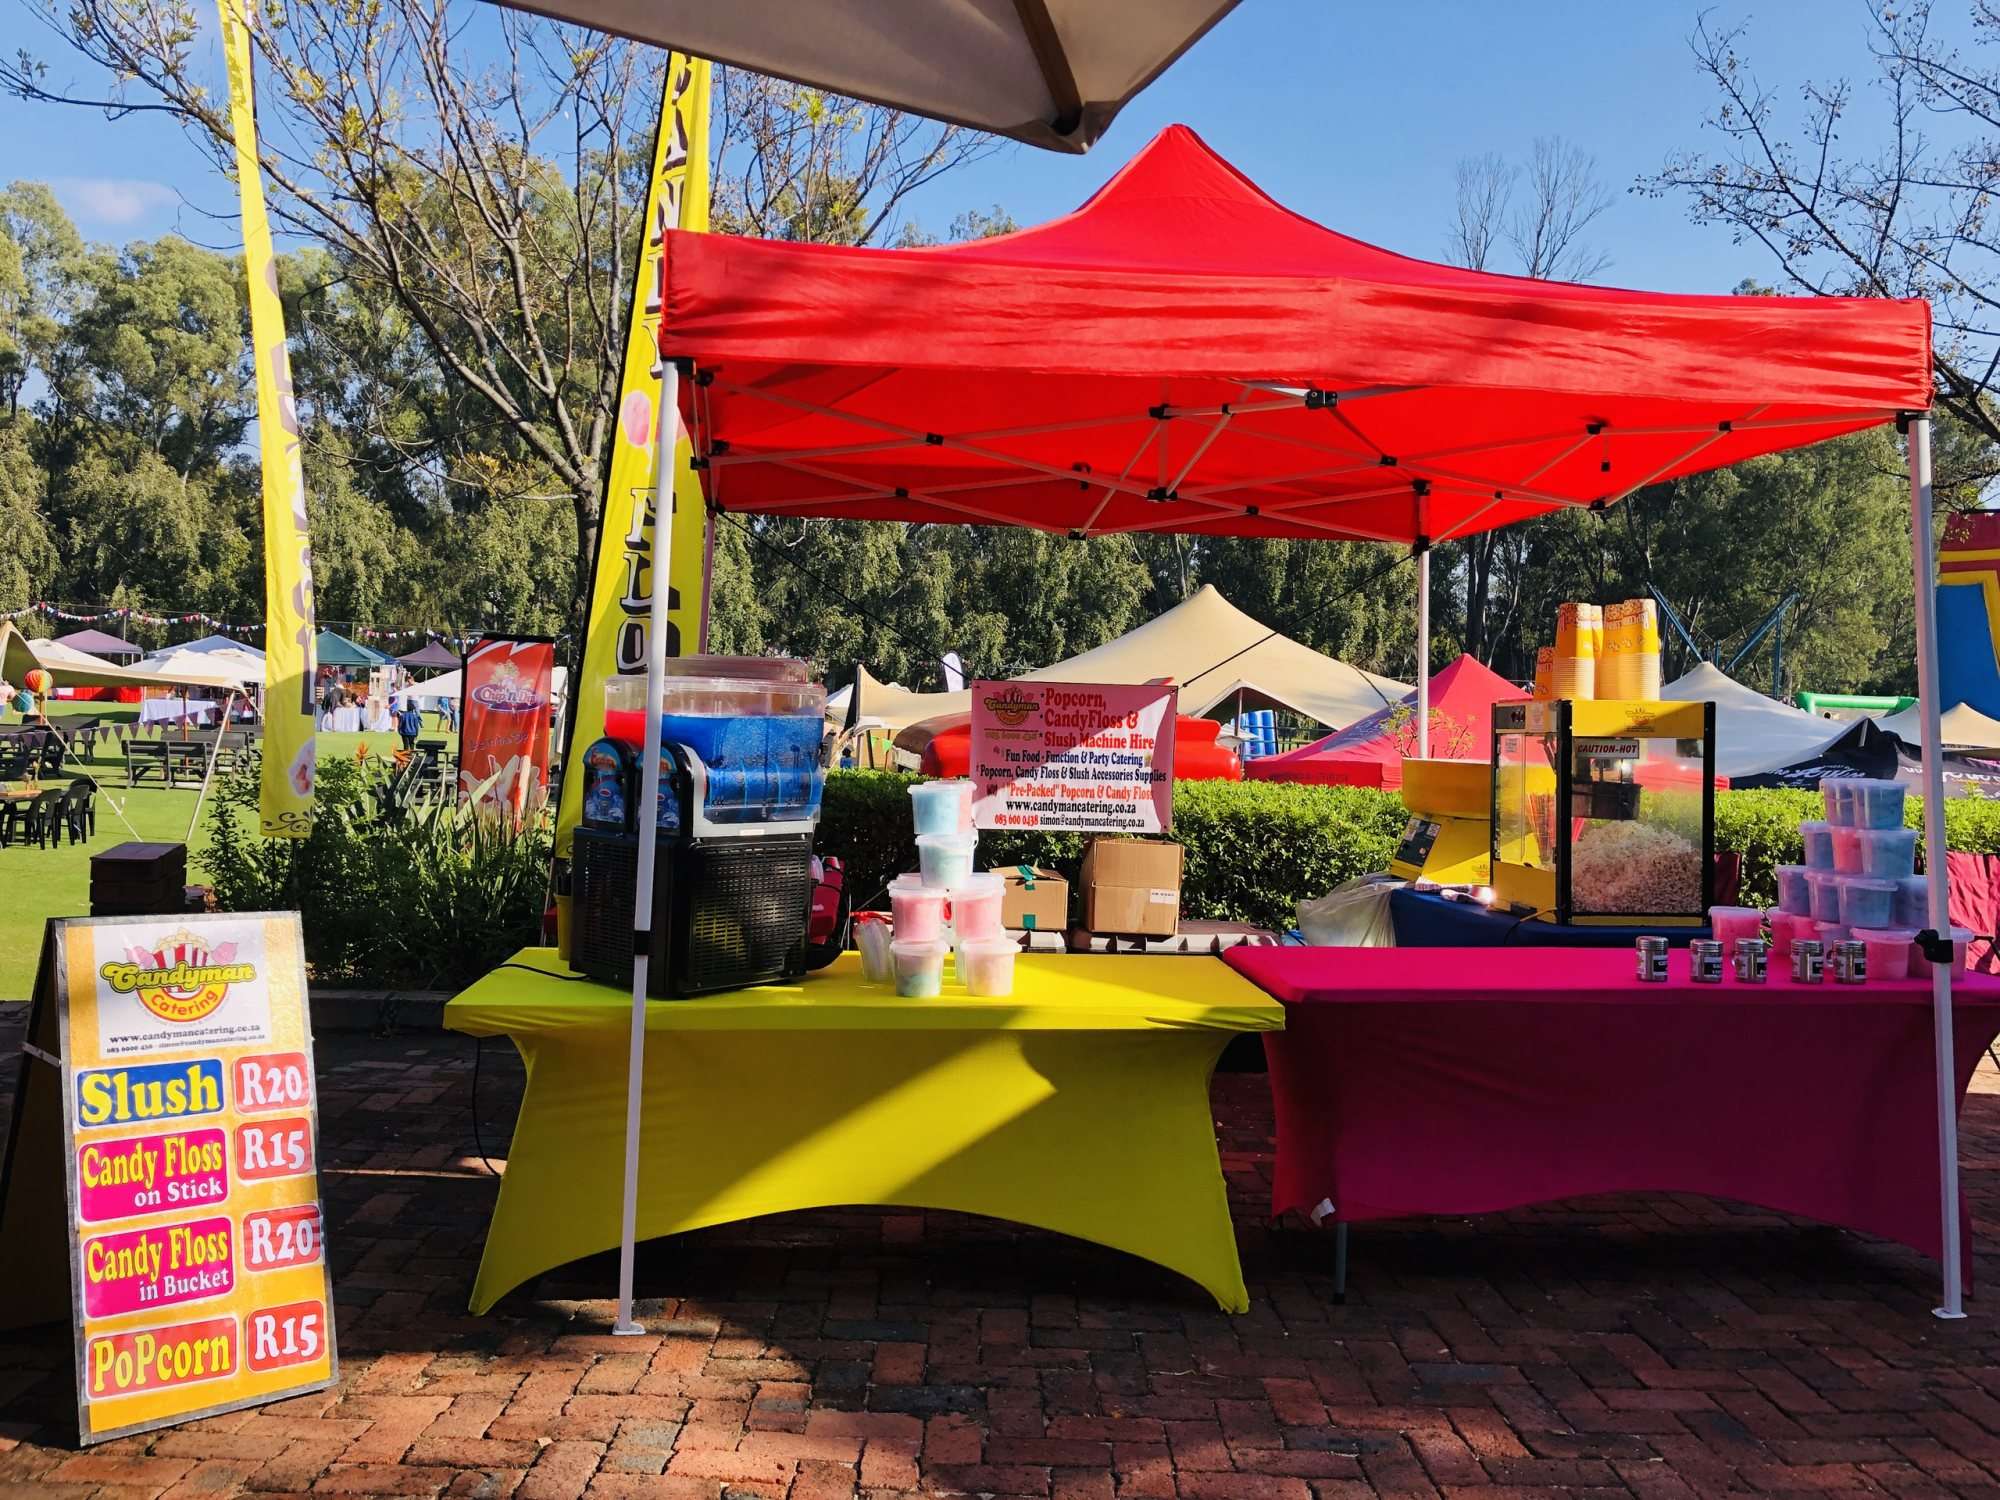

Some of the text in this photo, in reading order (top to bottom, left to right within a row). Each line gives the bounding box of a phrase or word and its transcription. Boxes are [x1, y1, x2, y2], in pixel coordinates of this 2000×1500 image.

[1044, 688, 1107, 712] Popcorn,
[1044, 708, 1123, 732] CandyFloss
[1126, 710, 1139, 730] &
[1044, 731, 1076, 748] Slush
[1080, 732, 1127, 749] Machine
[1129, 734, 1155, 750] Hire
[1006, 748, 1144, 769] Fun Food Function & Party Catering
[980, 764, 1167, 784] Popcorn, Candy Floss & Slush Accessories Supplies
[1061, 784, 1095, 801] Popcorn
[1097, 784, 1105, 799] &
[1106, 785, 1132, 802] Candy
[1006, 799, 1137, 816] www.candymancatering.co.za
[100, 960, 256, 994] Candyman
[151, 989, 219, 1016] Catering
[80, 1062, 301, 1124] Slush R20
[82, 1128, 305, 1188] Candy Floss R15
[134, 1176, 224, 1208] on Stick
[86, 1217, 314, 1282] Candy Floss R20
[139, 1267, 230, 1302] in Bucket
[93, 1313, 318, 1393] PoPcorn R15
